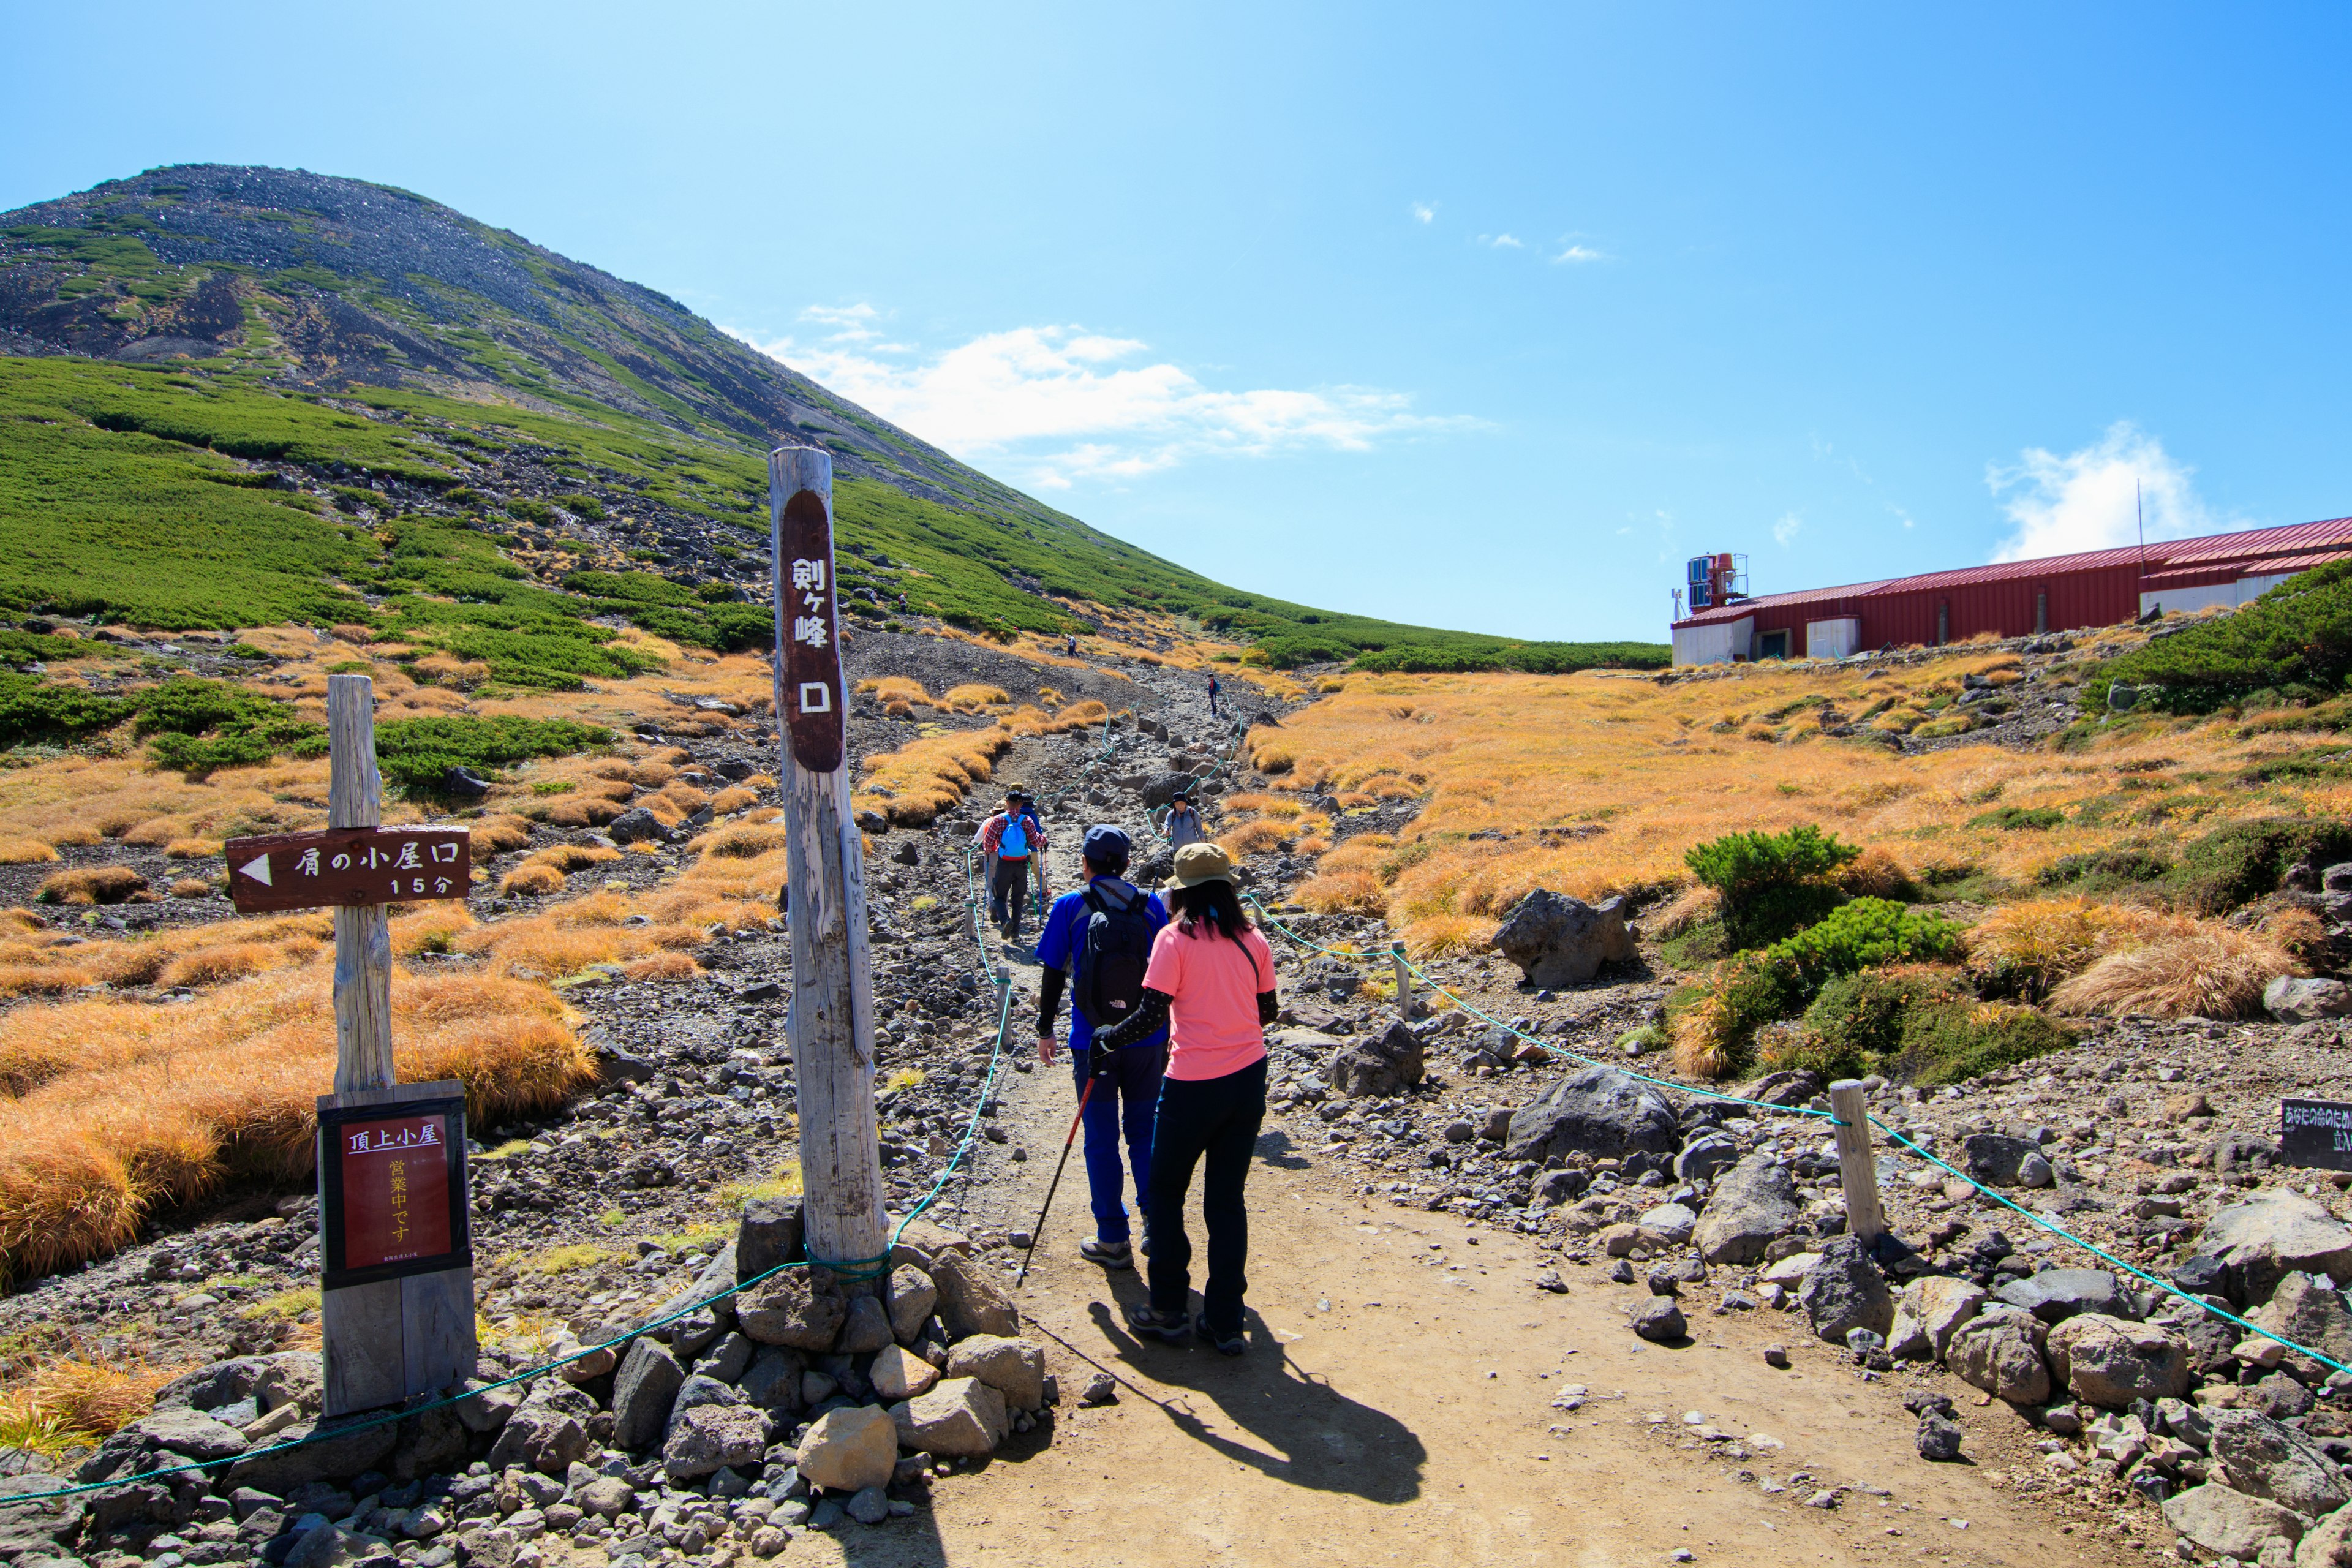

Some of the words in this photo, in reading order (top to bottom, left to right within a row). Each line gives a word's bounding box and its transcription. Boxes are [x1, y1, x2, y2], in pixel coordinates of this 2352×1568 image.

[295, 842, 459, 876] 肩の小屋口
[391, 876, 453, 894] 15分
[2285, 1106, 2352, 1129] あなたの命のため
[349, 1123, 439, 1151] 頂上小屋
[2332, 1130, 2352, 1152] 立入
[389, 1159, 409, 1243] 営業中です
